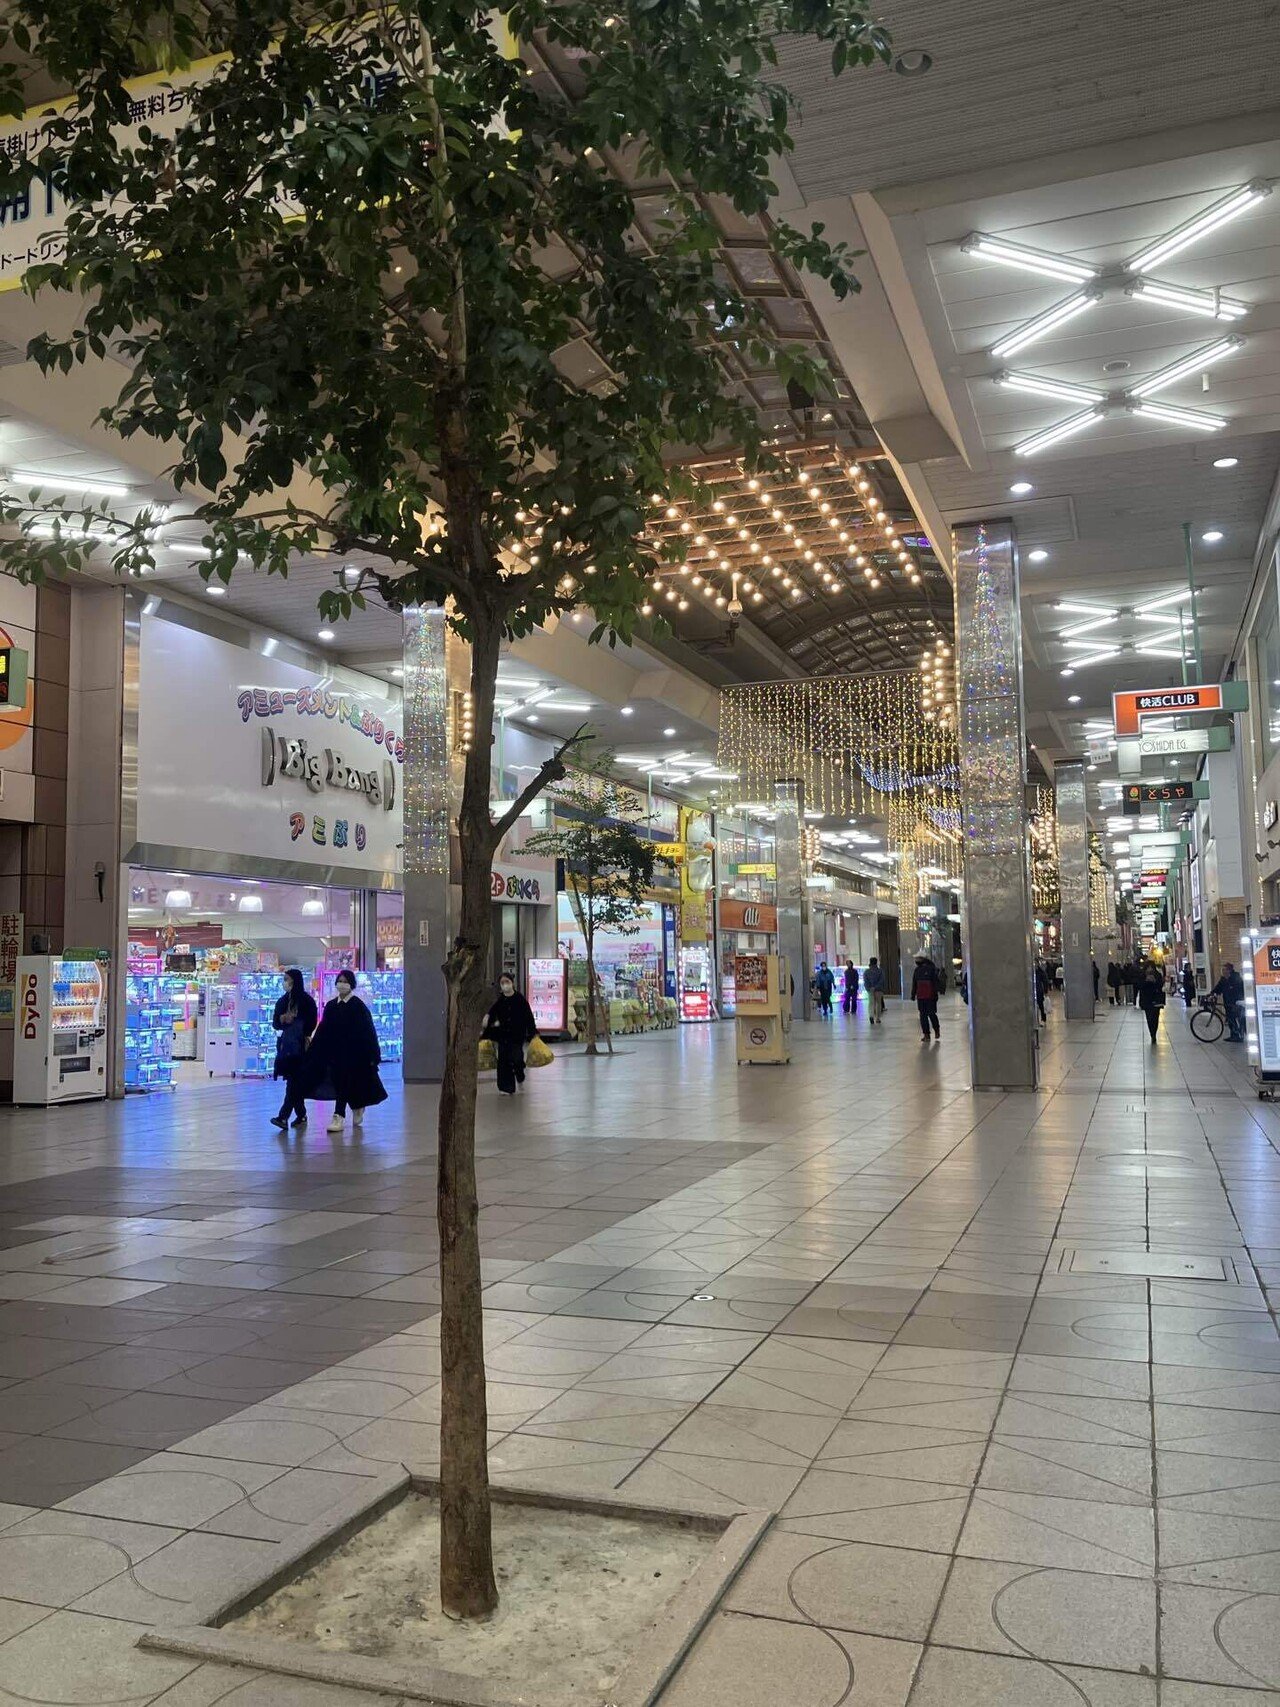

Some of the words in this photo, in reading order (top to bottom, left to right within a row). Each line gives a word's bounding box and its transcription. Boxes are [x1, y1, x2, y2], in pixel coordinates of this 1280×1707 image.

[1140, 693, 1195, 708] 快活CLUB
[278, 736, 325, 793] Big
[324, 748, 382, 805] Bang
[1148, 787, 1185, 801] とらや
[0, 914, 20, 983] 駐輪場
[24, 973, 41, 1040] DyDo
